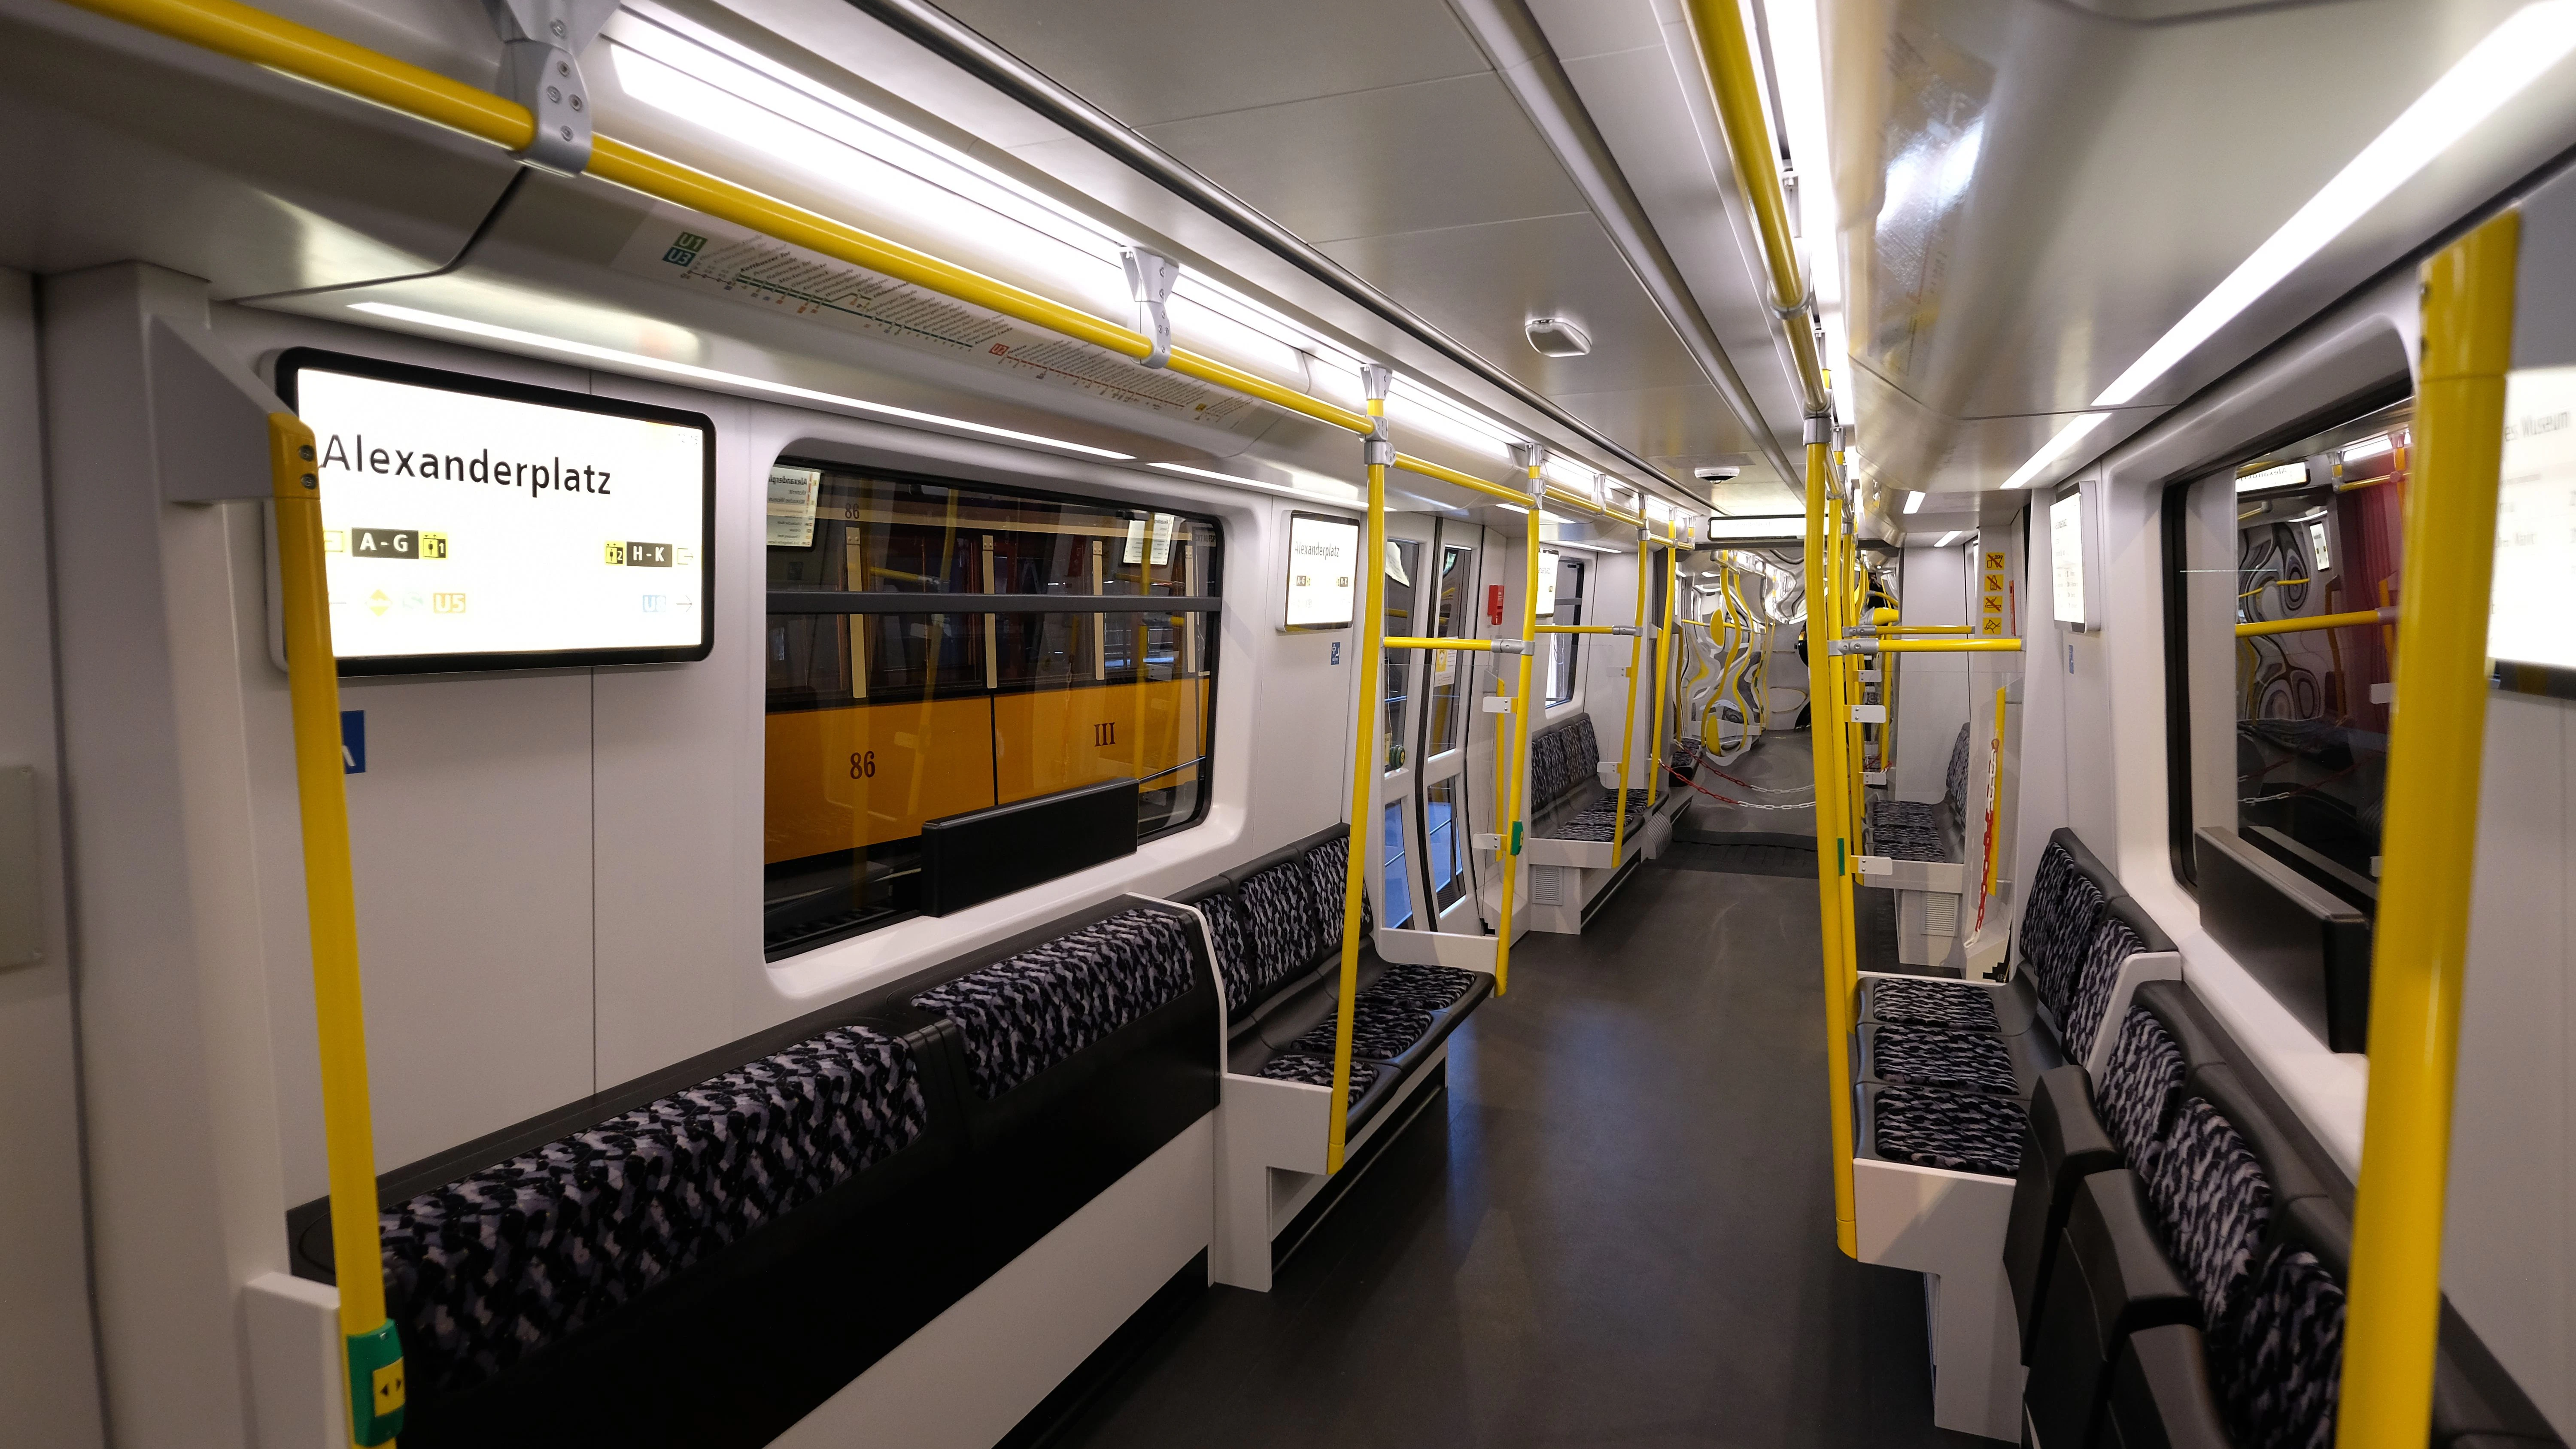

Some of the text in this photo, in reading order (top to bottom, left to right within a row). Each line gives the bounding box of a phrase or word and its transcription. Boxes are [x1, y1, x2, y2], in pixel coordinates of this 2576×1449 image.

[679, 234, 703, 249] U1
[668, 249, 692, 264] U3
[991, 344, 1007, 355] U2
[321, 433, 611, 498] Alexanderplatz
[844, 503, 860, 519] 86
[439, 542, 445, 554] 1
[617, 550, 623, 560] 2
[1295, 541, 1340, 560] Alexanderplatz
[435, 594, 465, 613] U5
[1094, 722, 1116, 746] III
[850, 750, 875, 779] 86
